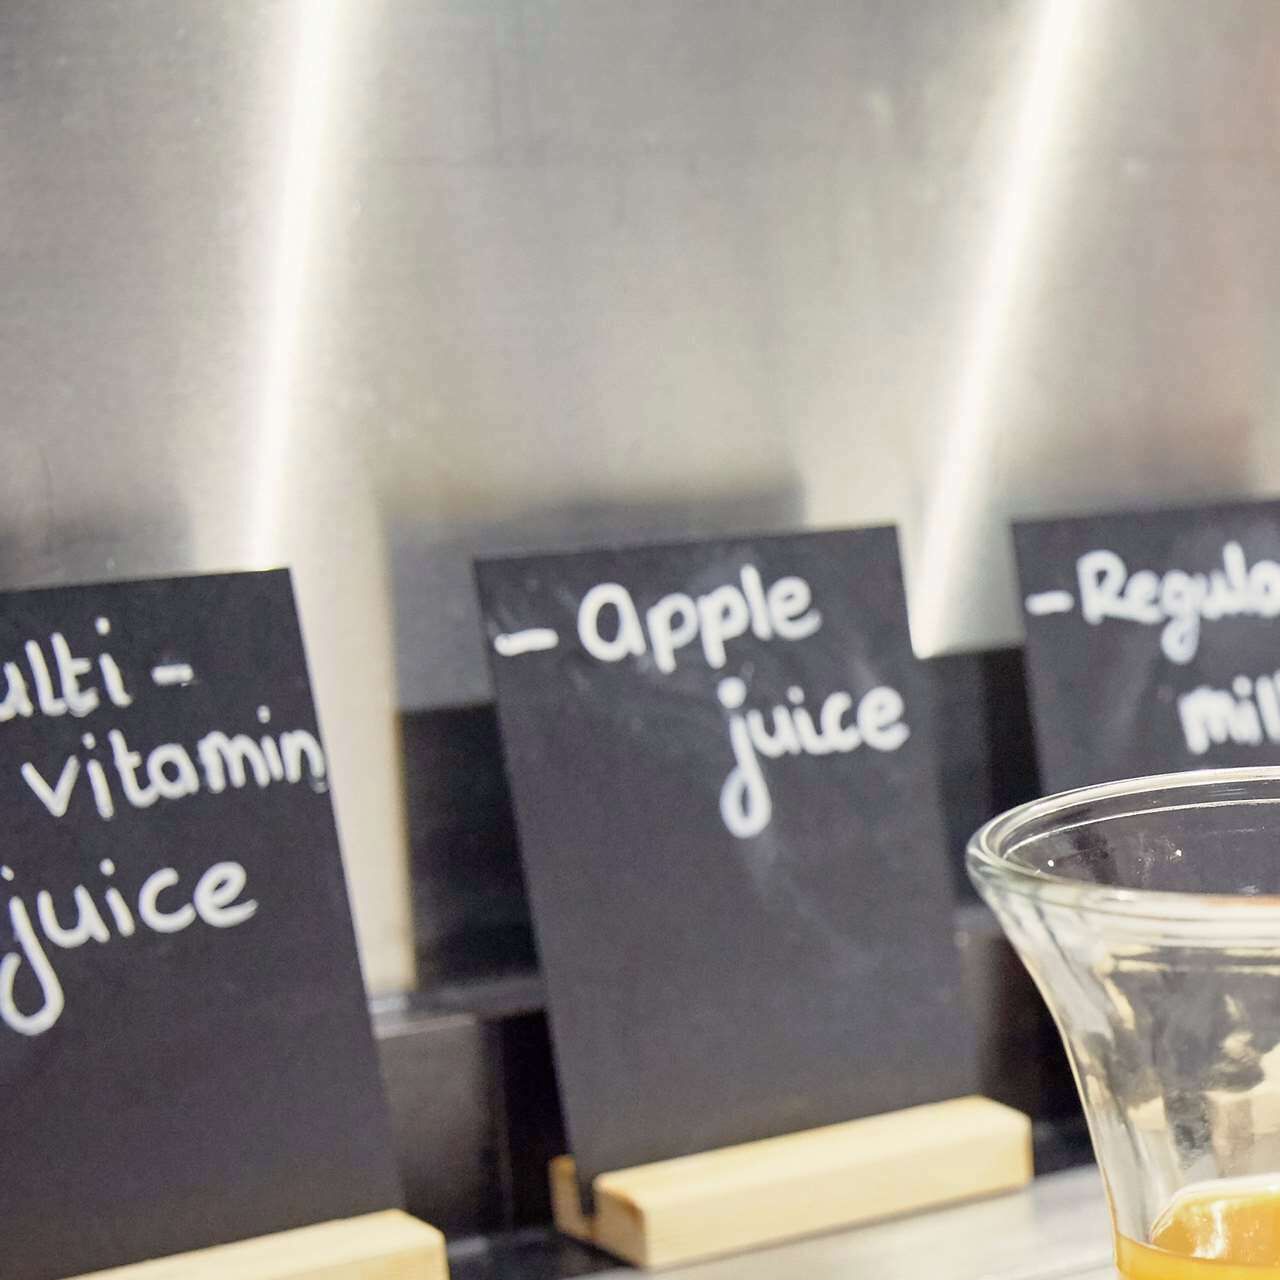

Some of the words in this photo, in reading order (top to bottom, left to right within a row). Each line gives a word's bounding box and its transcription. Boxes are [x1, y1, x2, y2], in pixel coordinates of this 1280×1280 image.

[22, 704, 328, 818] vitamin
[717, 676, 910, 839] juice
[0, 858, 258, 1035] juice
